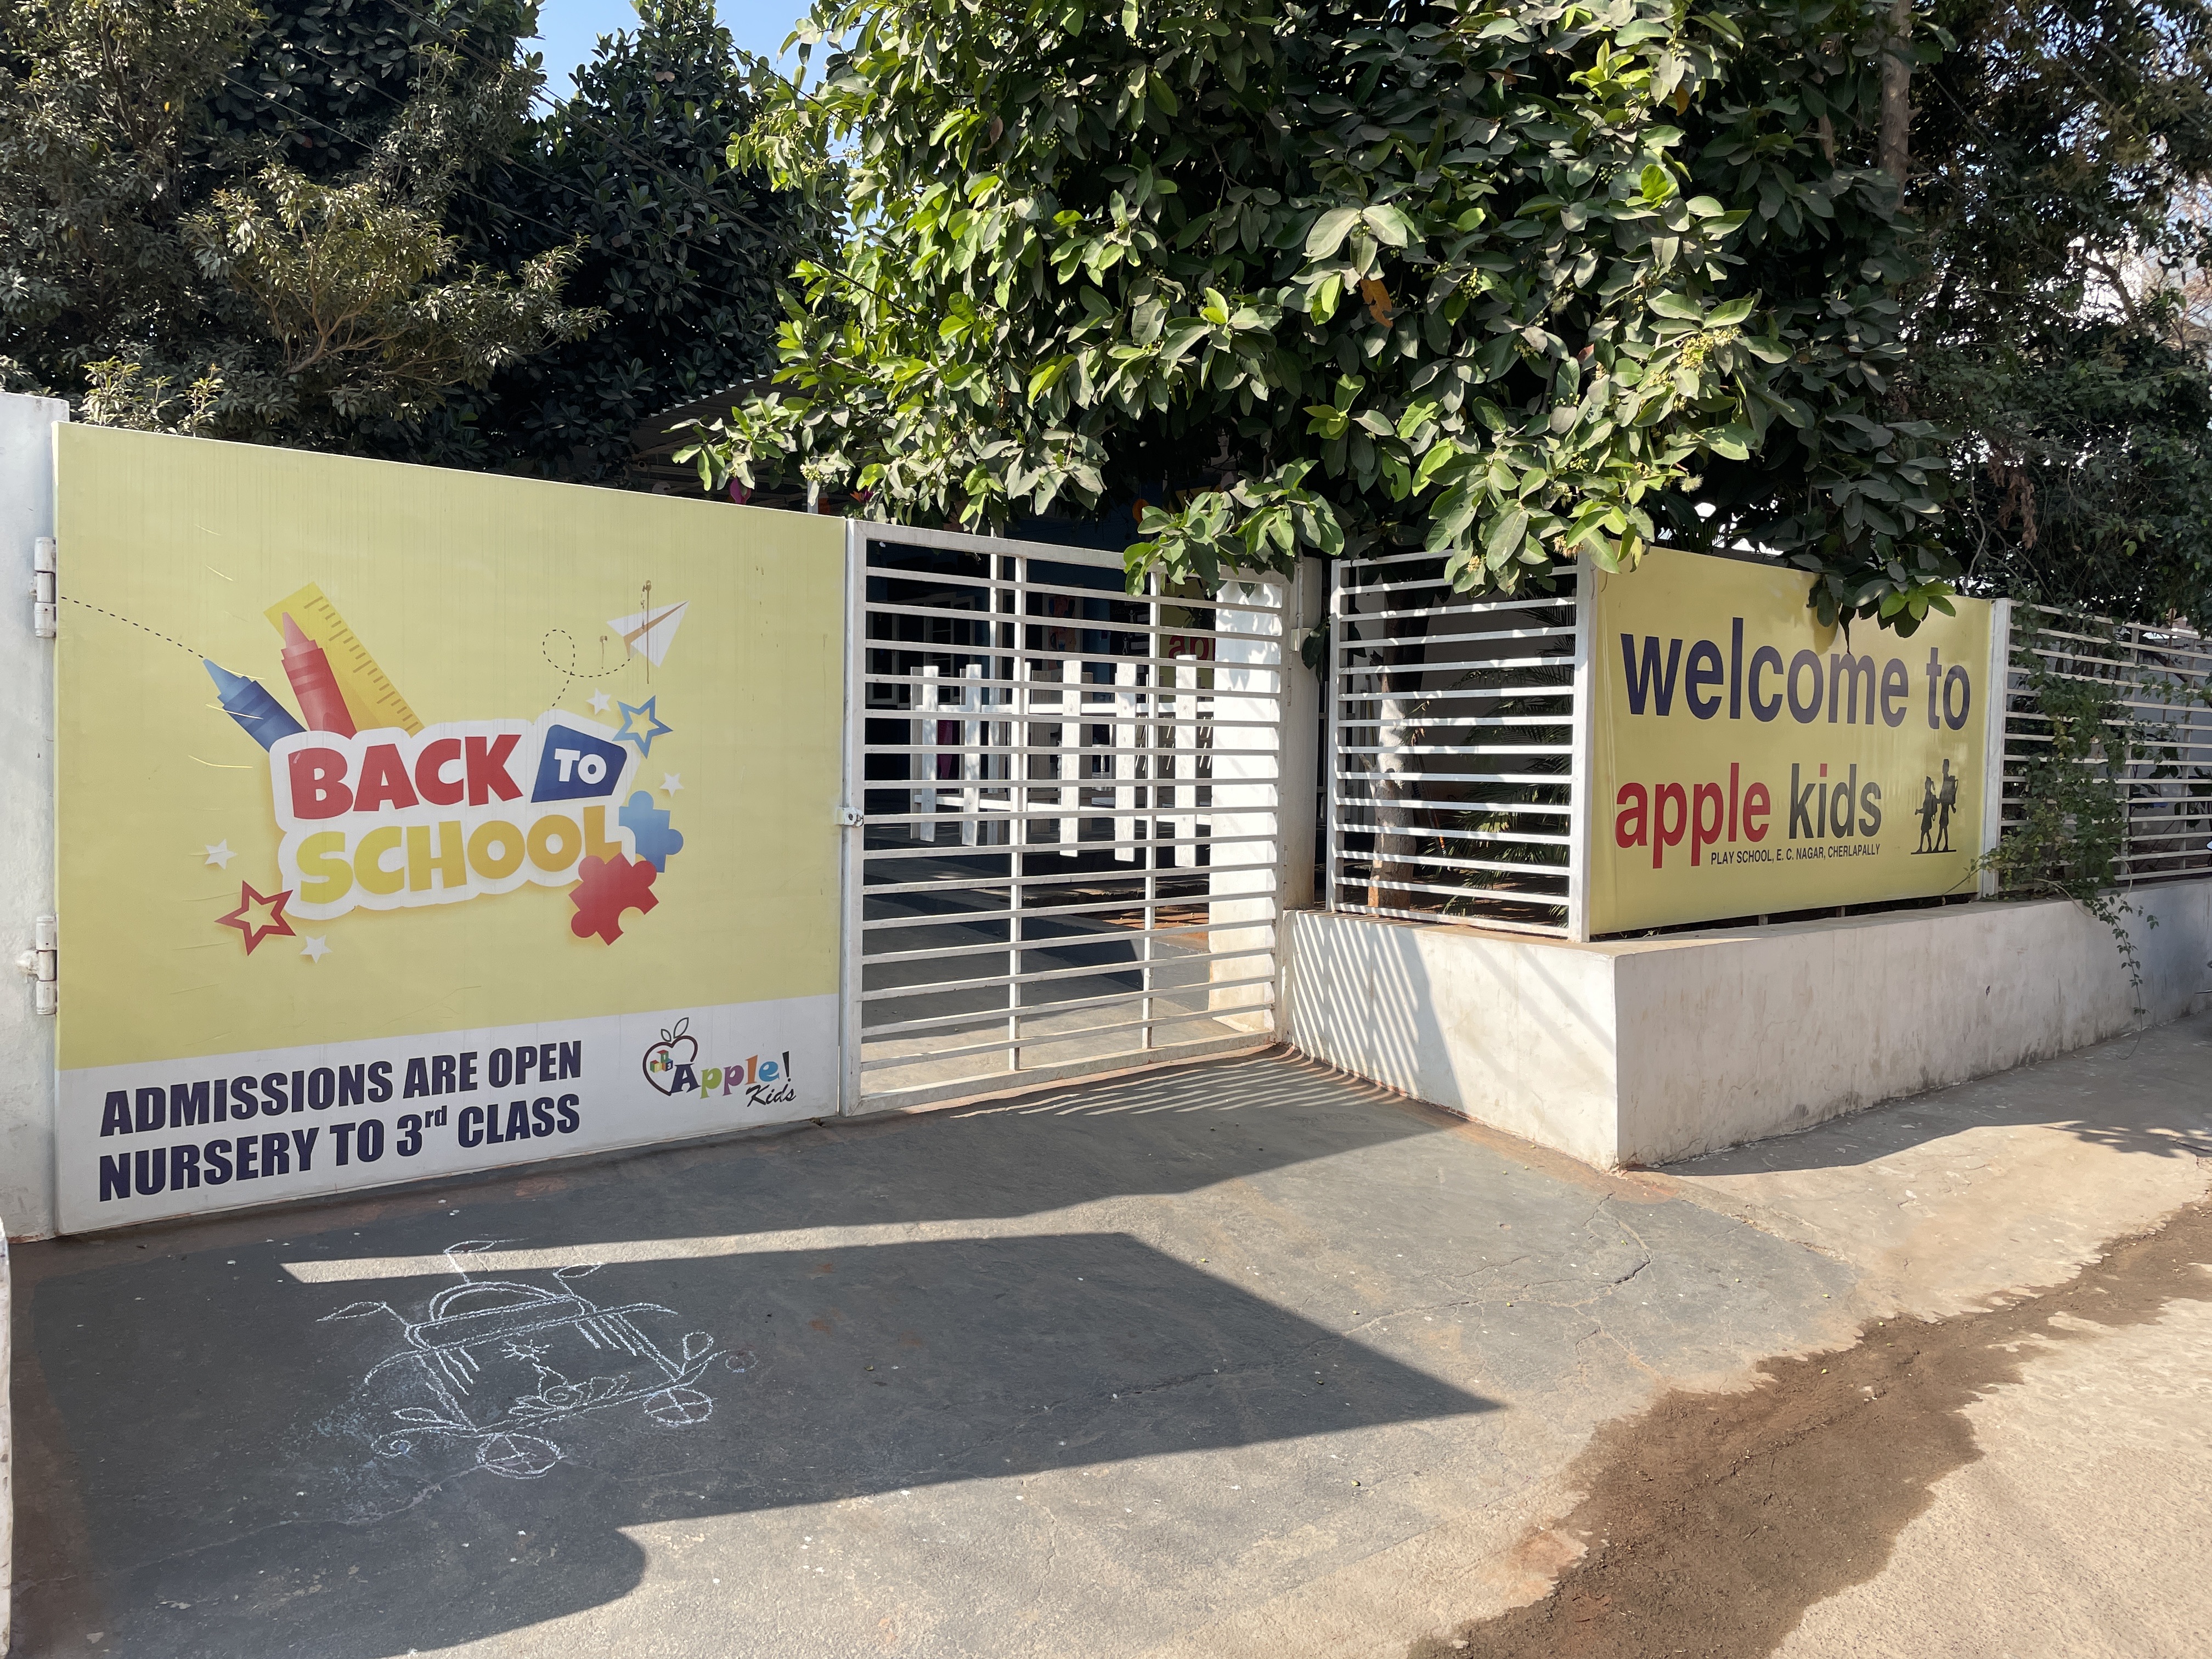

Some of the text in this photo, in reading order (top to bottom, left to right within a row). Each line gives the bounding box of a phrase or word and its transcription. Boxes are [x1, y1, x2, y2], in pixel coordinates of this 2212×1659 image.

[1169, 635, 1216, 661] ap
[1620, 617, 1970, 730] welcome to
[288, 734, 607, 820] BACK TO
[1615, 763, 1882, 869] apple kids
[296, 805, 622, 904] SCHOOL
[1711, 844, 1880, 865] PLAY SCHOOL, E. C. NAGAR, CHERLAPALLY
[99, 1040, 582, 1137] ADMISSIONS ARE OPEN
[670, 1051, 791, 1099] Apple!
[746, 1084, 797, 1107] Kids
[99, 1093, 580, 1203] NURSERY TO 3rd CLASS
